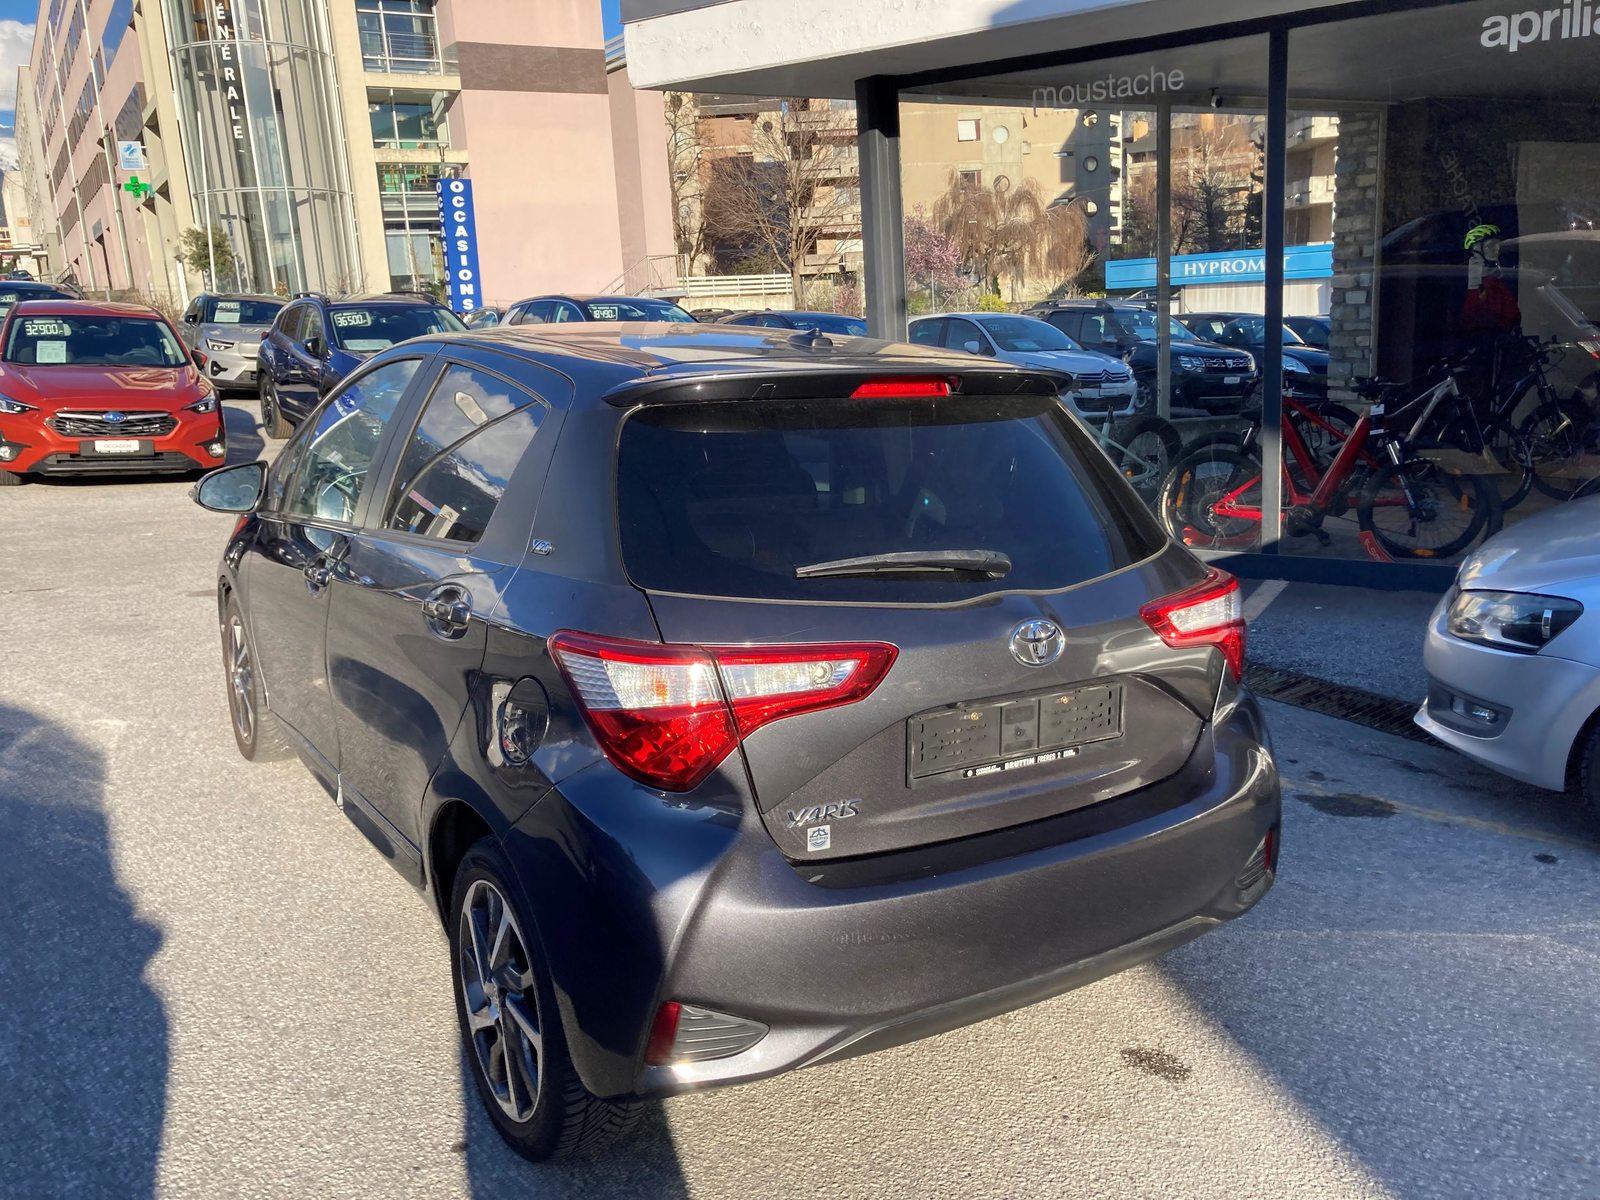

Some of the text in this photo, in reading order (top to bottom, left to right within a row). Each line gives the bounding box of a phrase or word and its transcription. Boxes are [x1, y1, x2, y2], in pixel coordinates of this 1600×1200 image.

[1480, 0, 1600, 52] aprilia
[1032, 65, 1185, 117] moustache
[449, 180, 474, 310] OCCASIONS
[1184, 256, 1290, 275] HYPROMT
[1004, 757, 1035, 770] BRUTTIN
